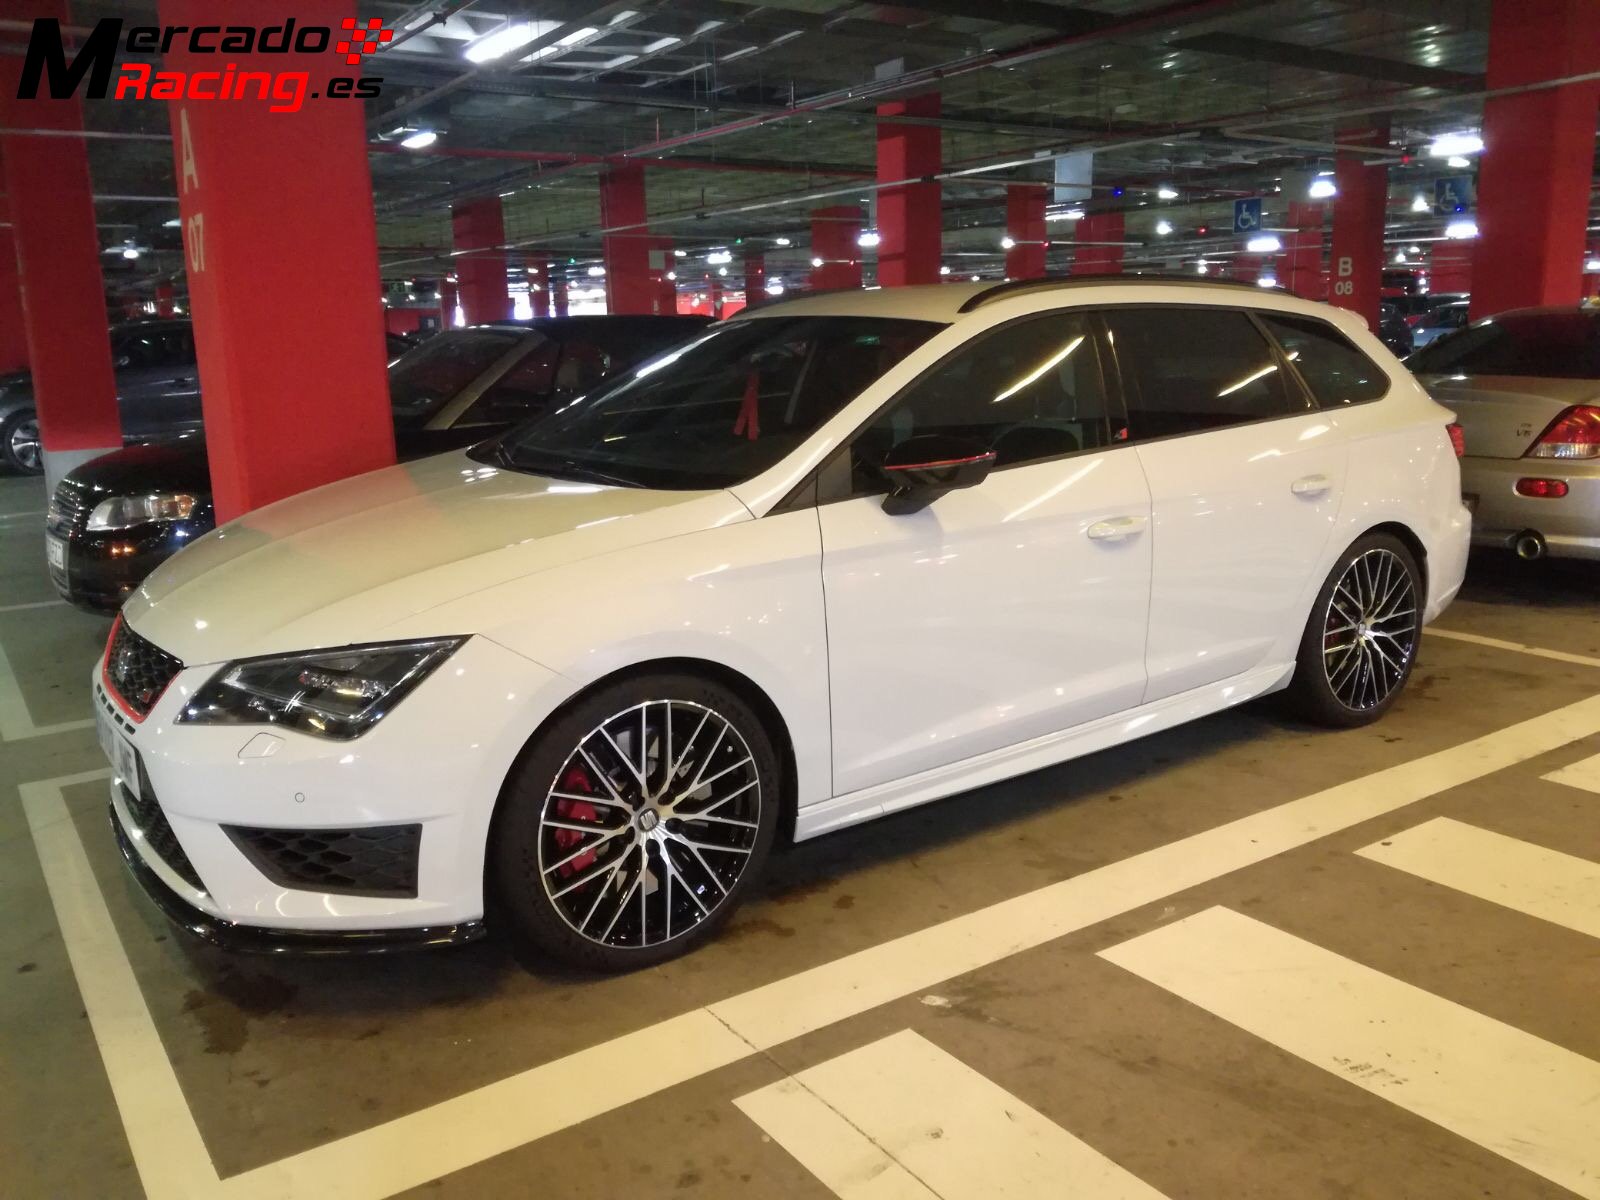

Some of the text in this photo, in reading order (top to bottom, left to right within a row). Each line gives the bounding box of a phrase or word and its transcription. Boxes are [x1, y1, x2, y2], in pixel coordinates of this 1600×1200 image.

[181, 108, 199, 193] A
[188, 213, 205, 272] 07
[1338, 256, 1352, 276] B
[1335, 281, 1353, 295] 08
